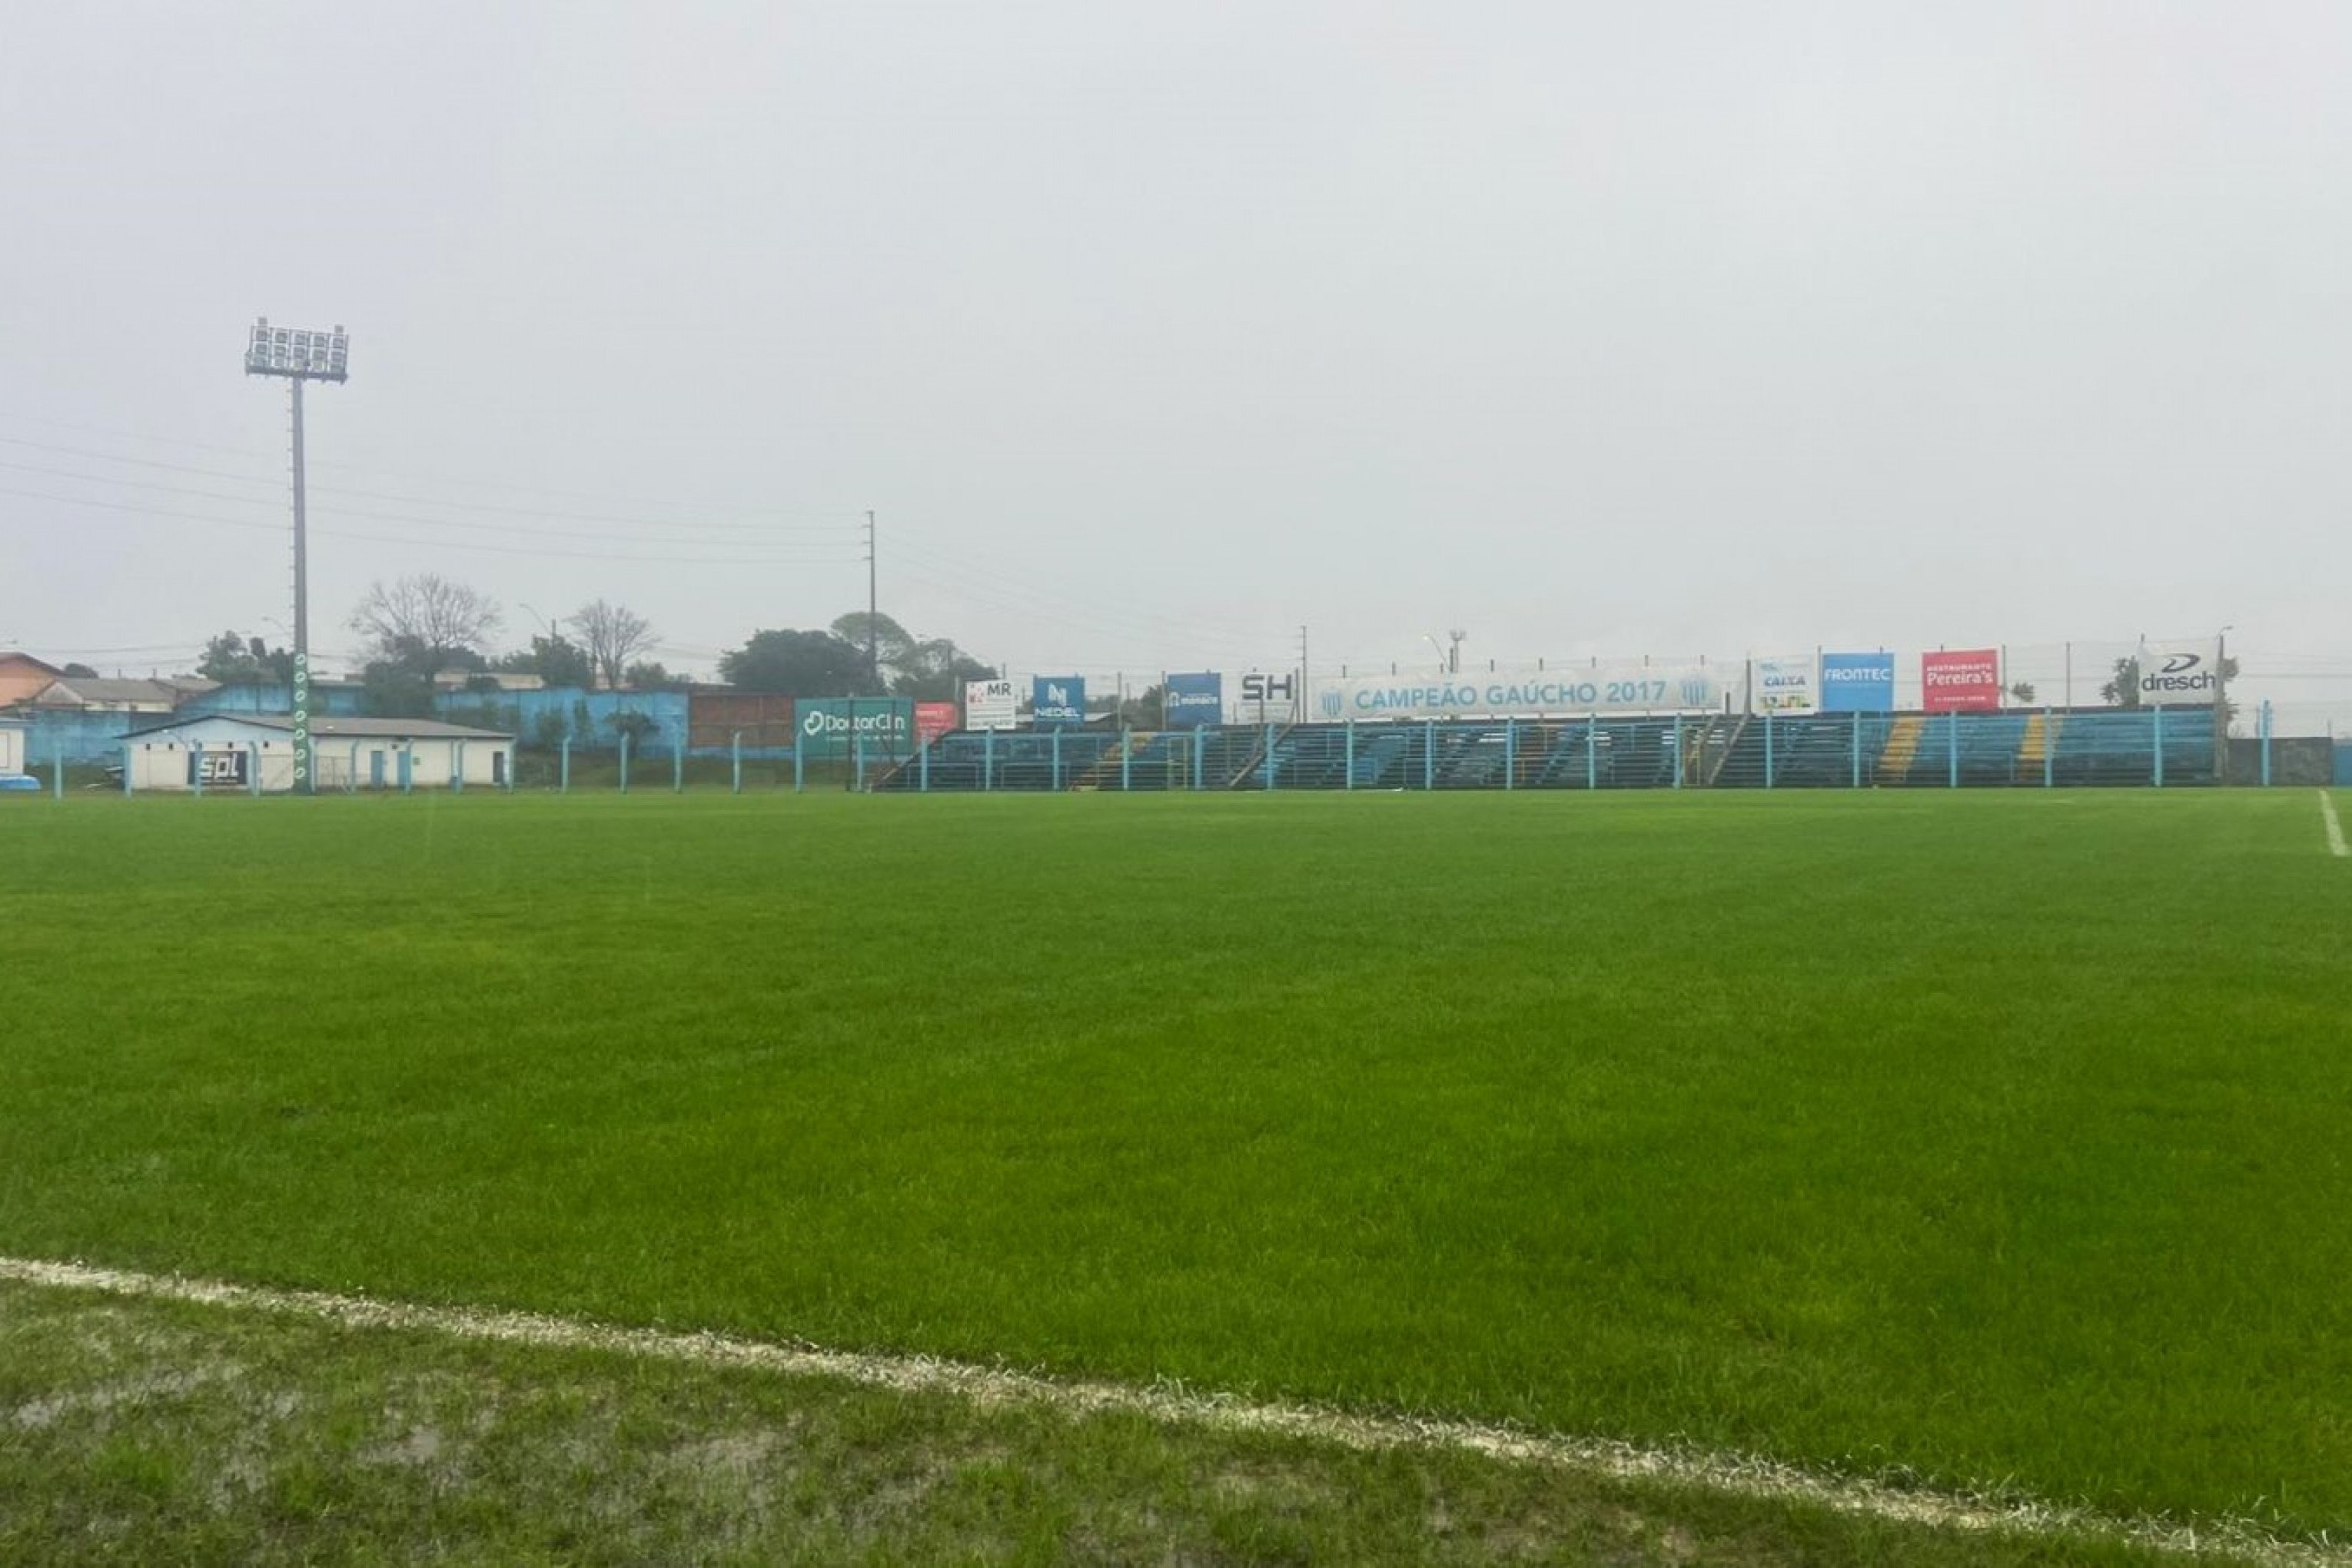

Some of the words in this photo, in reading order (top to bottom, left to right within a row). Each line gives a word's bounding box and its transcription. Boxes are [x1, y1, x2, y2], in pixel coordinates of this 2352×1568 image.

[987, 683, 1012, 696] MR
[1242, 673, 1292, 700] SH
[2142, 671, 2215, 690] dresch
[1355, 682, 1477, 709] CAMPEÃO
[1486, 679, 1596, 706] GAÚCHO
[1606, 680, 1666, 702] 2017
[825, 714, 905, 731] DotorCln
